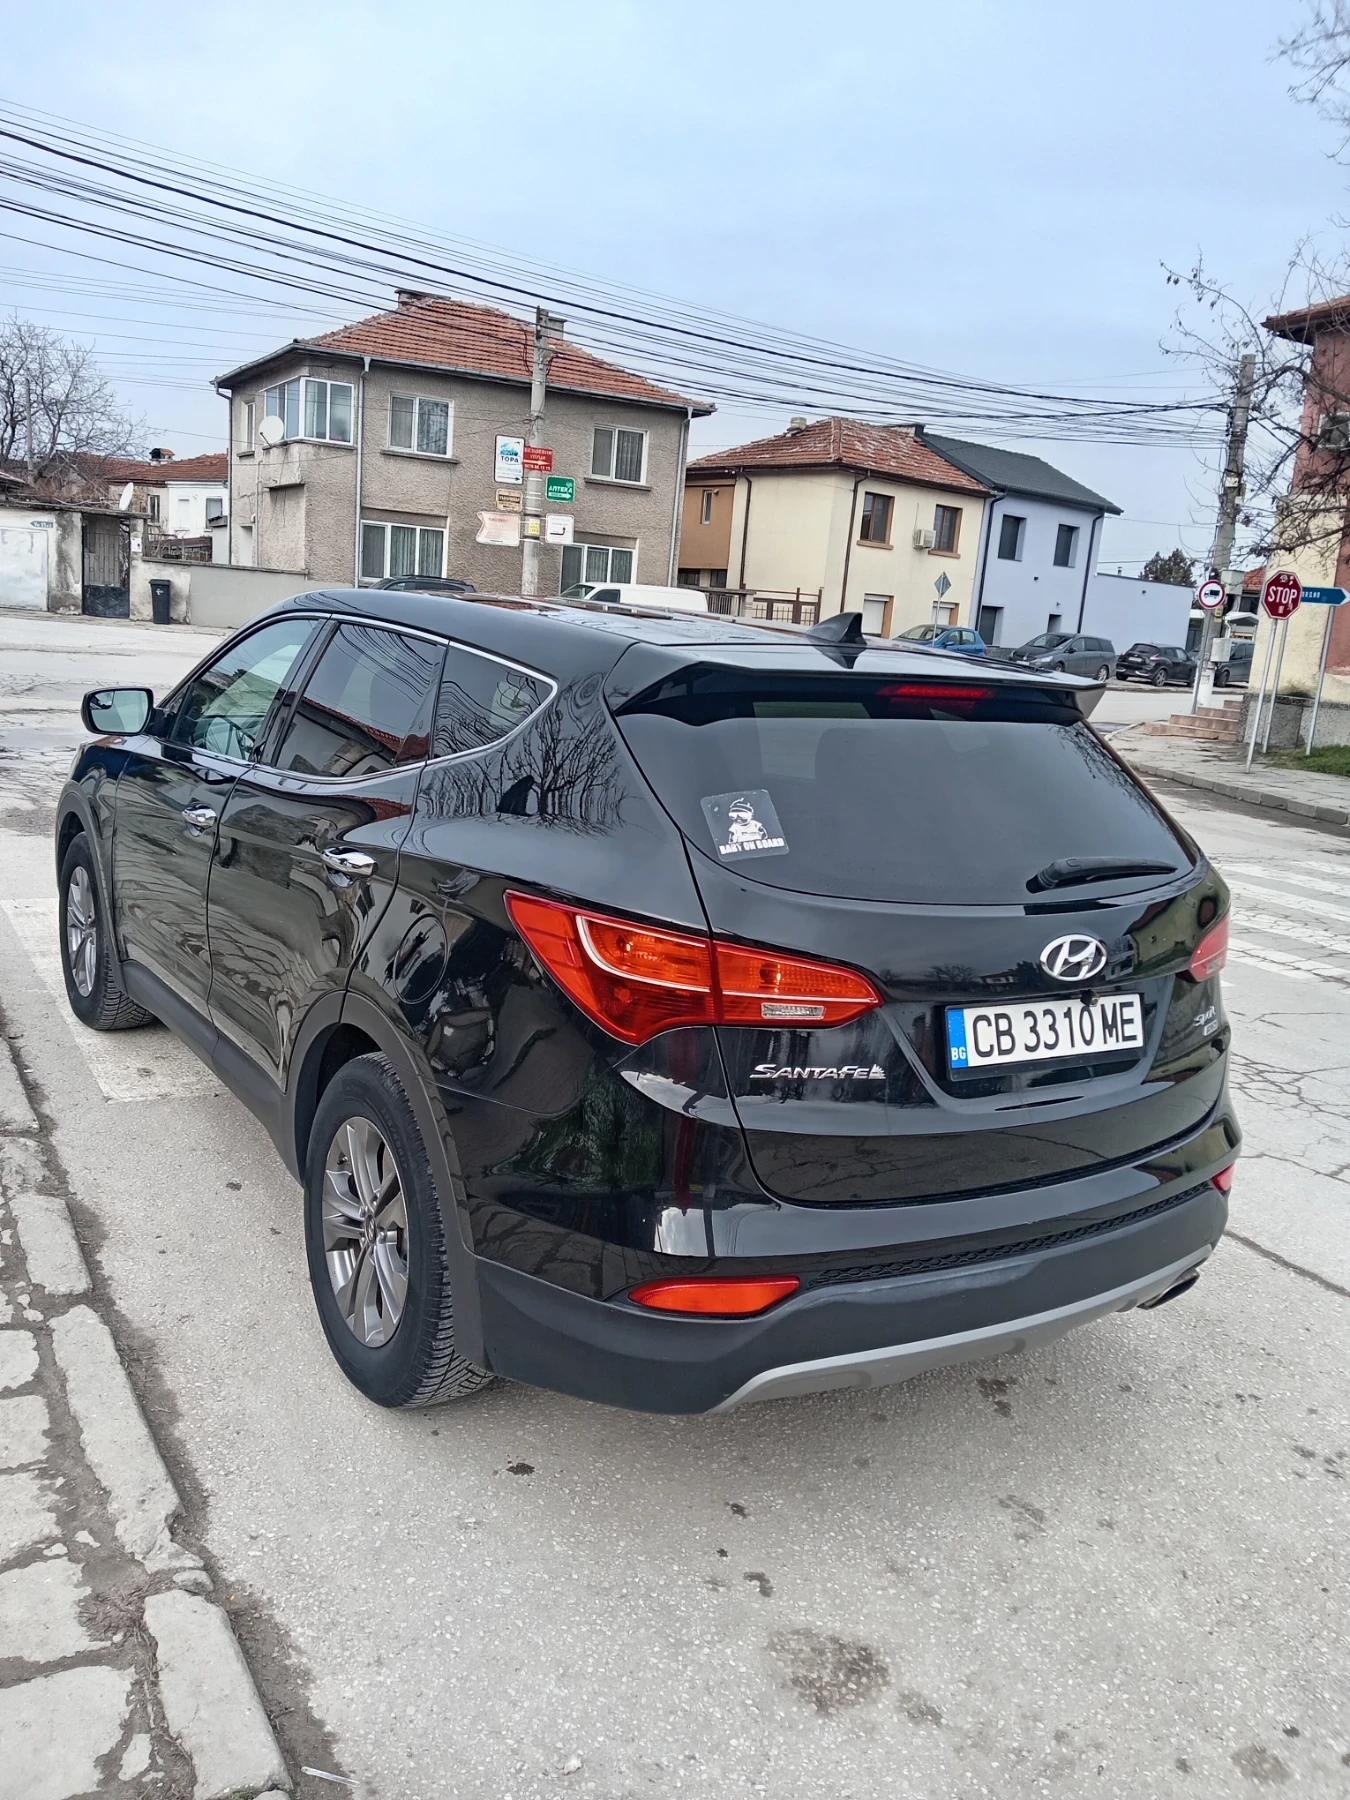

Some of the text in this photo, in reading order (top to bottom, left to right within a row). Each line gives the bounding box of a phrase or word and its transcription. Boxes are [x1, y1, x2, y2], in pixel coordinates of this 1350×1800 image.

[548, 485, 573, 494] АПТЕКА
[1267, 586, 1298, 604] STOP
[719, 837, 785, 855] BABY ON BOARD
[972, 1001, 1138, 1058] CB 3310 ME
[951, 1046, 967, 1061] BG
